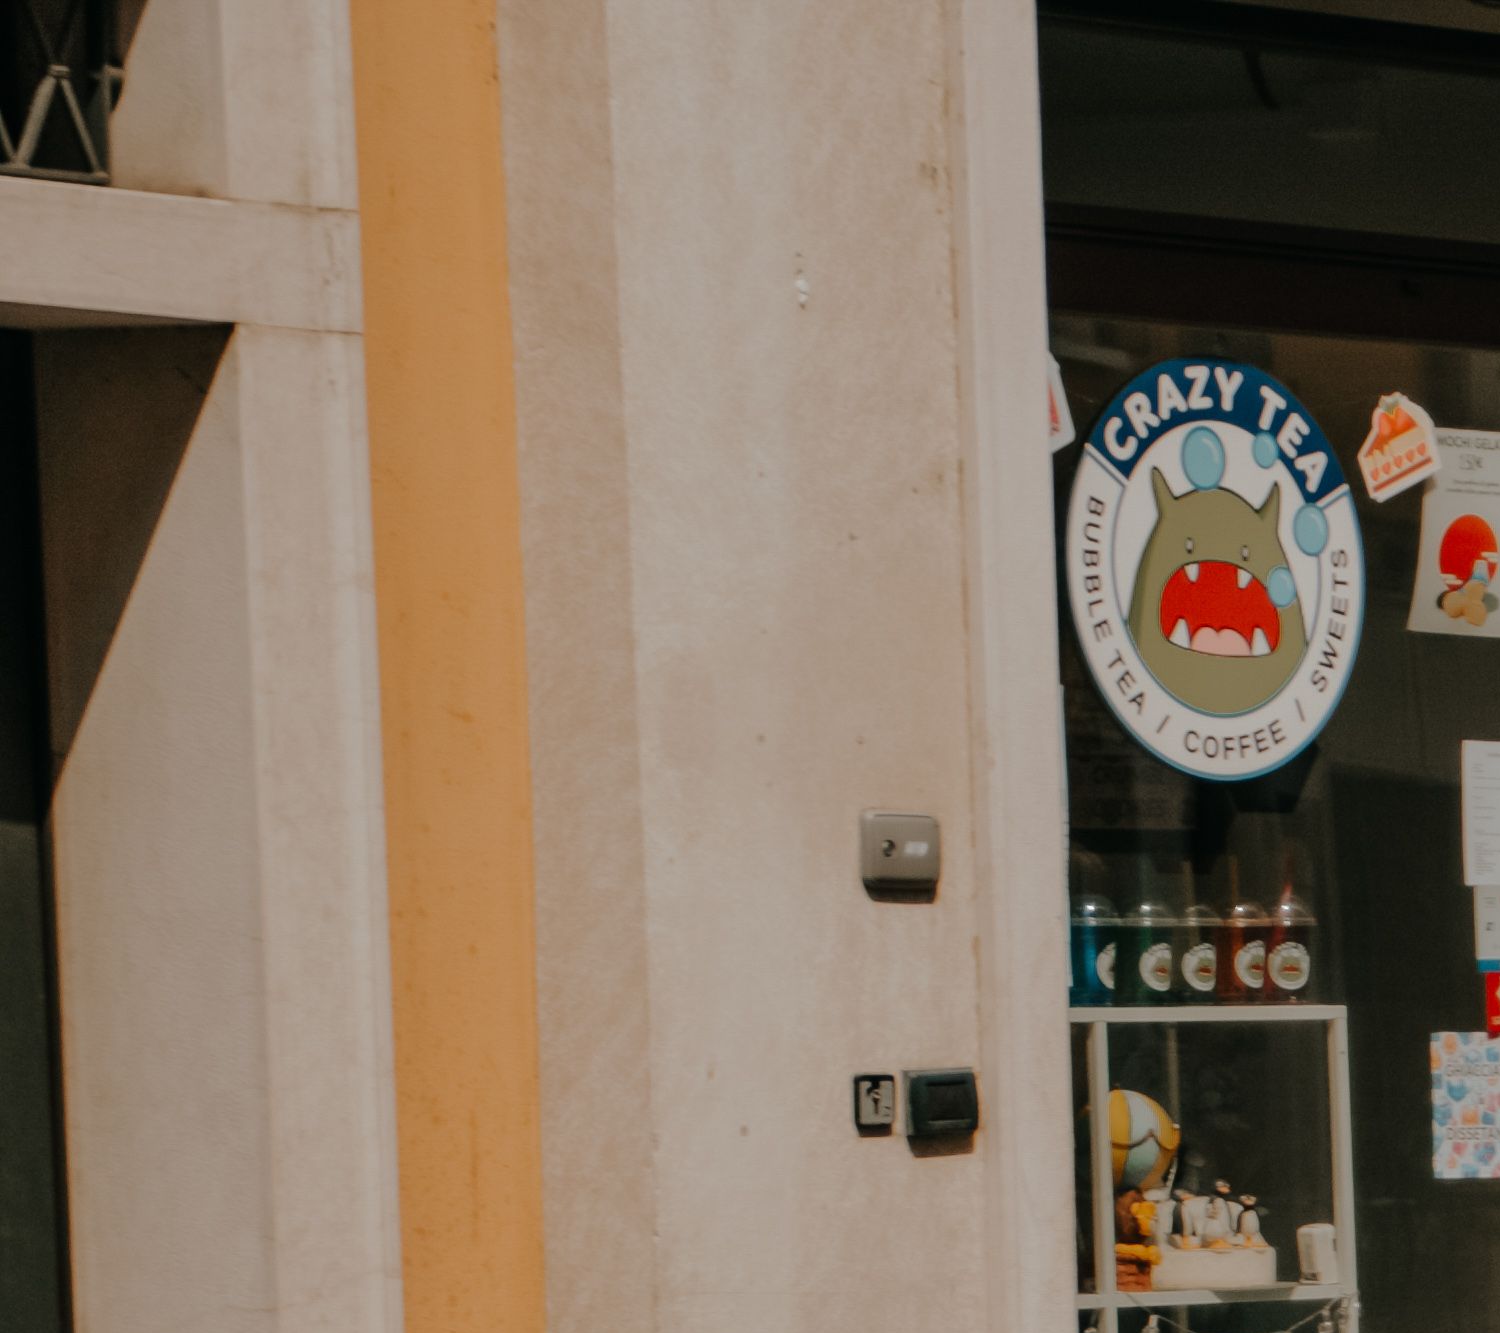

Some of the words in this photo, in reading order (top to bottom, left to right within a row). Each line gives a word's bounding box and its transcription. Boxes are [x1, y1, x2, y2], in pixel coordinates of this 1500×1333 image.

[1103, 365, 1244, 461] CRAZY
[1257, 385, 1329, 493] TEA
[1082, 495, 1111, 640] BUBBLE
[1106, 649, 1147, 716] TEA
[1184, 720, 1287, 760] COFFEE
[1310, 549, 1350, 694] SWEETS
